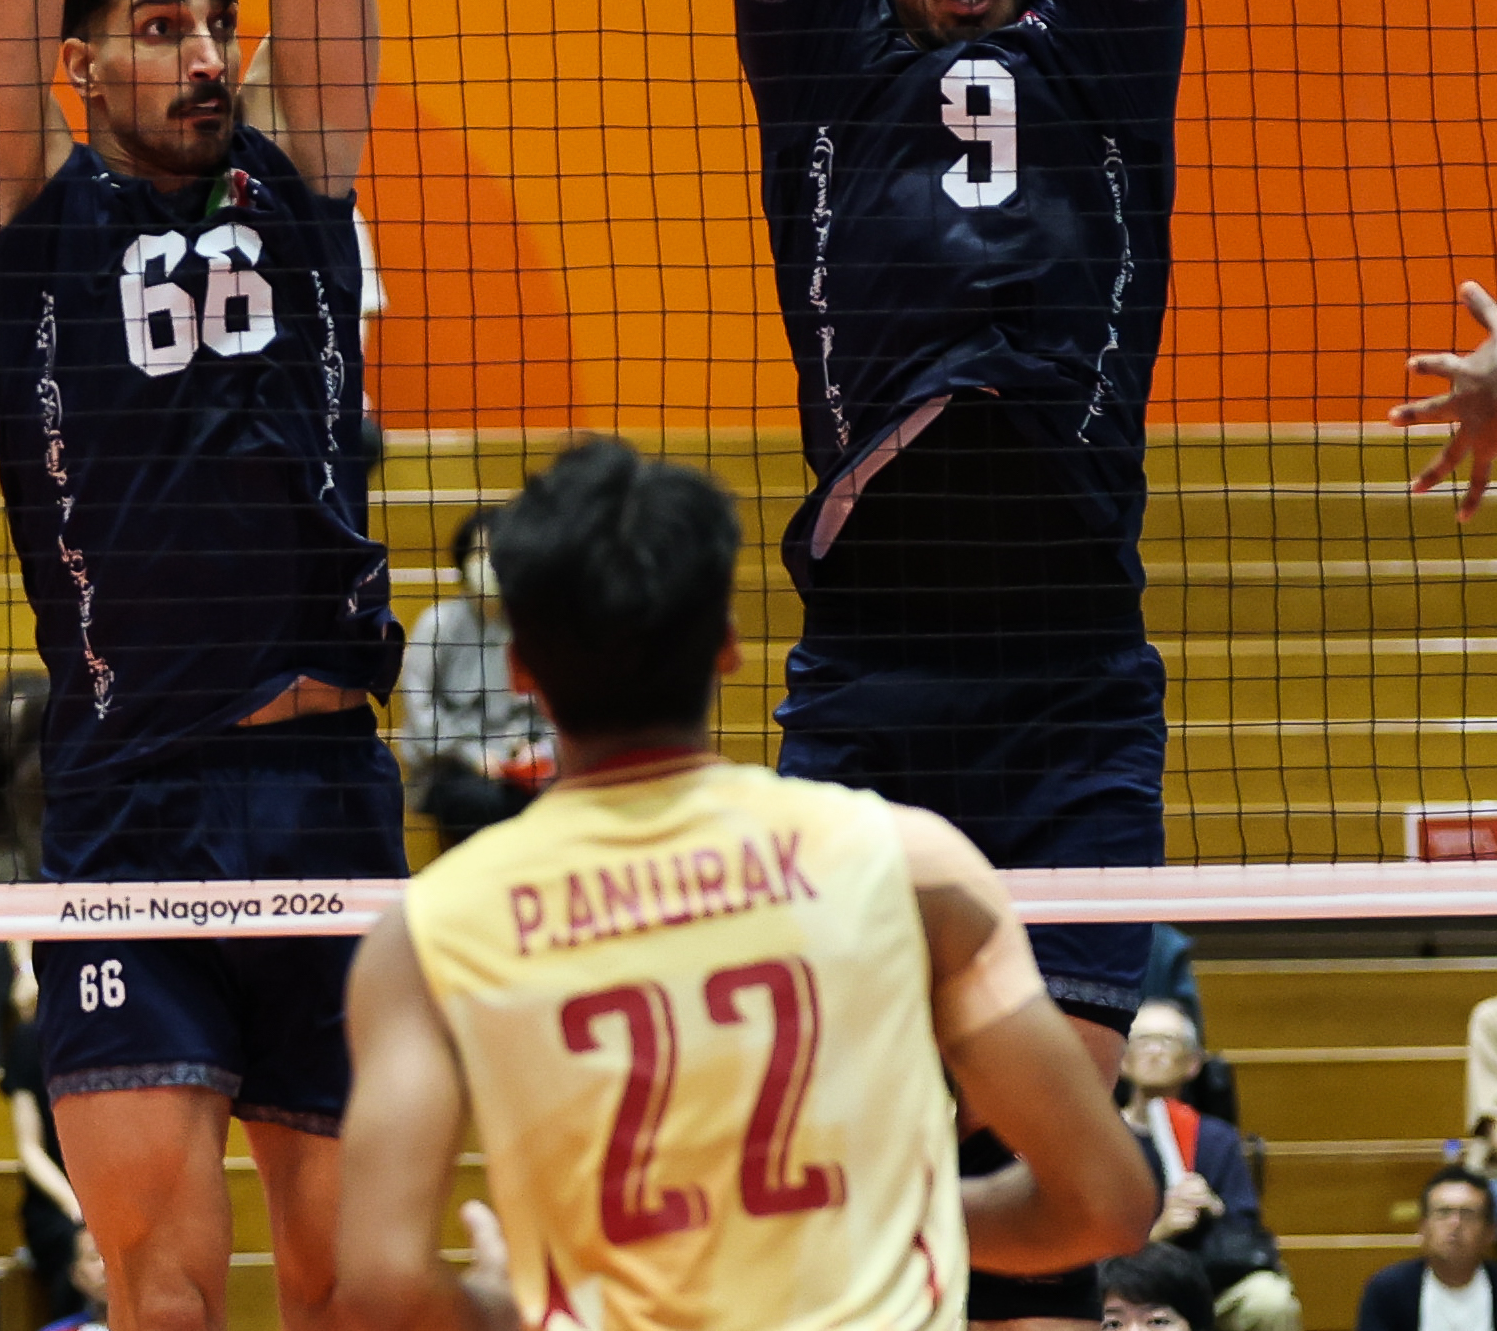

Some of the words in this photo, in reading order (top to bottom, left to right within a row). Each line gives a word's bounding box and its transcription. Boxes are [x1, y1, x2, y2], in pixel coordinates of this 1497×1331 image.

[940, 59, 1017, 209] 9
[120, 223, 279, 378] 66
[60, 896, 261, 926] Aichi-Nagoya
[272, 893, 344, 916] 2026
[508, 829, 819, 958] P.ANURAK
[79, 958, 126, 1013] 66
[560, 955, 846, 1246] 22
